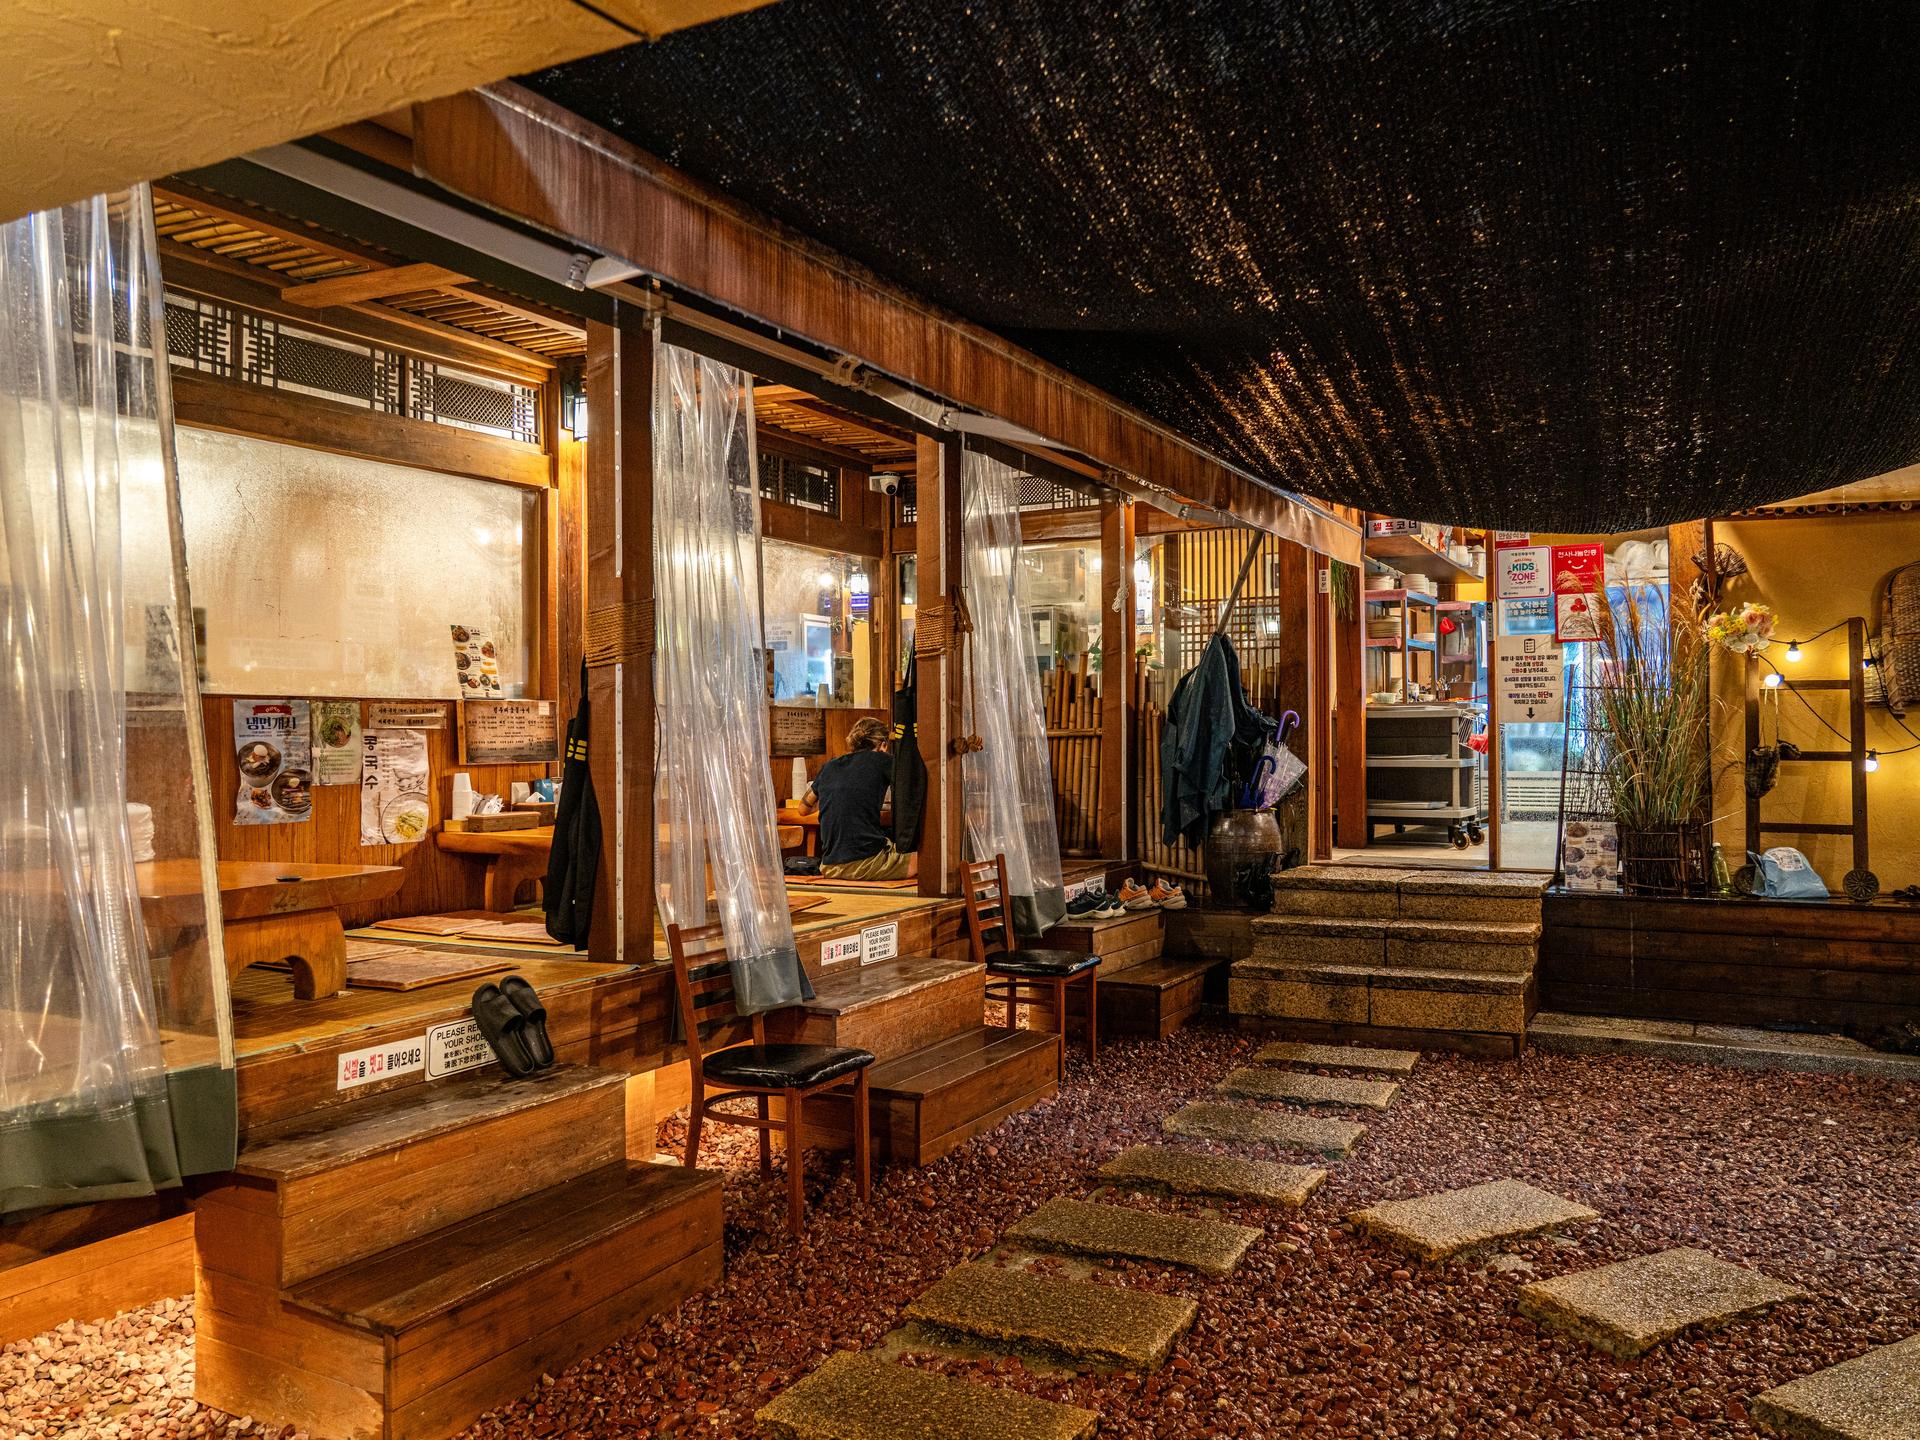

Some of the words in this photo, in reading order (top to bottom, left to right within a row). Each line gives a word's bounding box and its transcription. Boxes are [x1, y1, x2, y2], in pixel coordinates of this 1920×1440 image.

[1512, 562, 1534, 572] KIDS
[1512, 572, 1536, 581] ZONE
[246, 716, 296, 730] 냉면개시
[364, 736, 378, 790] 콩국수
[865, 930, 879, 939] PLEASE
[880, 927, 894, 935] REMOVE
[879, 935, 890, 943] SHOES
[437, 1026, 465, 1040] PLEASE
[444, 1037, 464, 1049] YOUR
[344, 1058, 366, 1082] 신발을
[369, 1053, 384, 1075] 벗고
[388, 1048, 421, 1071] 들어오세요
